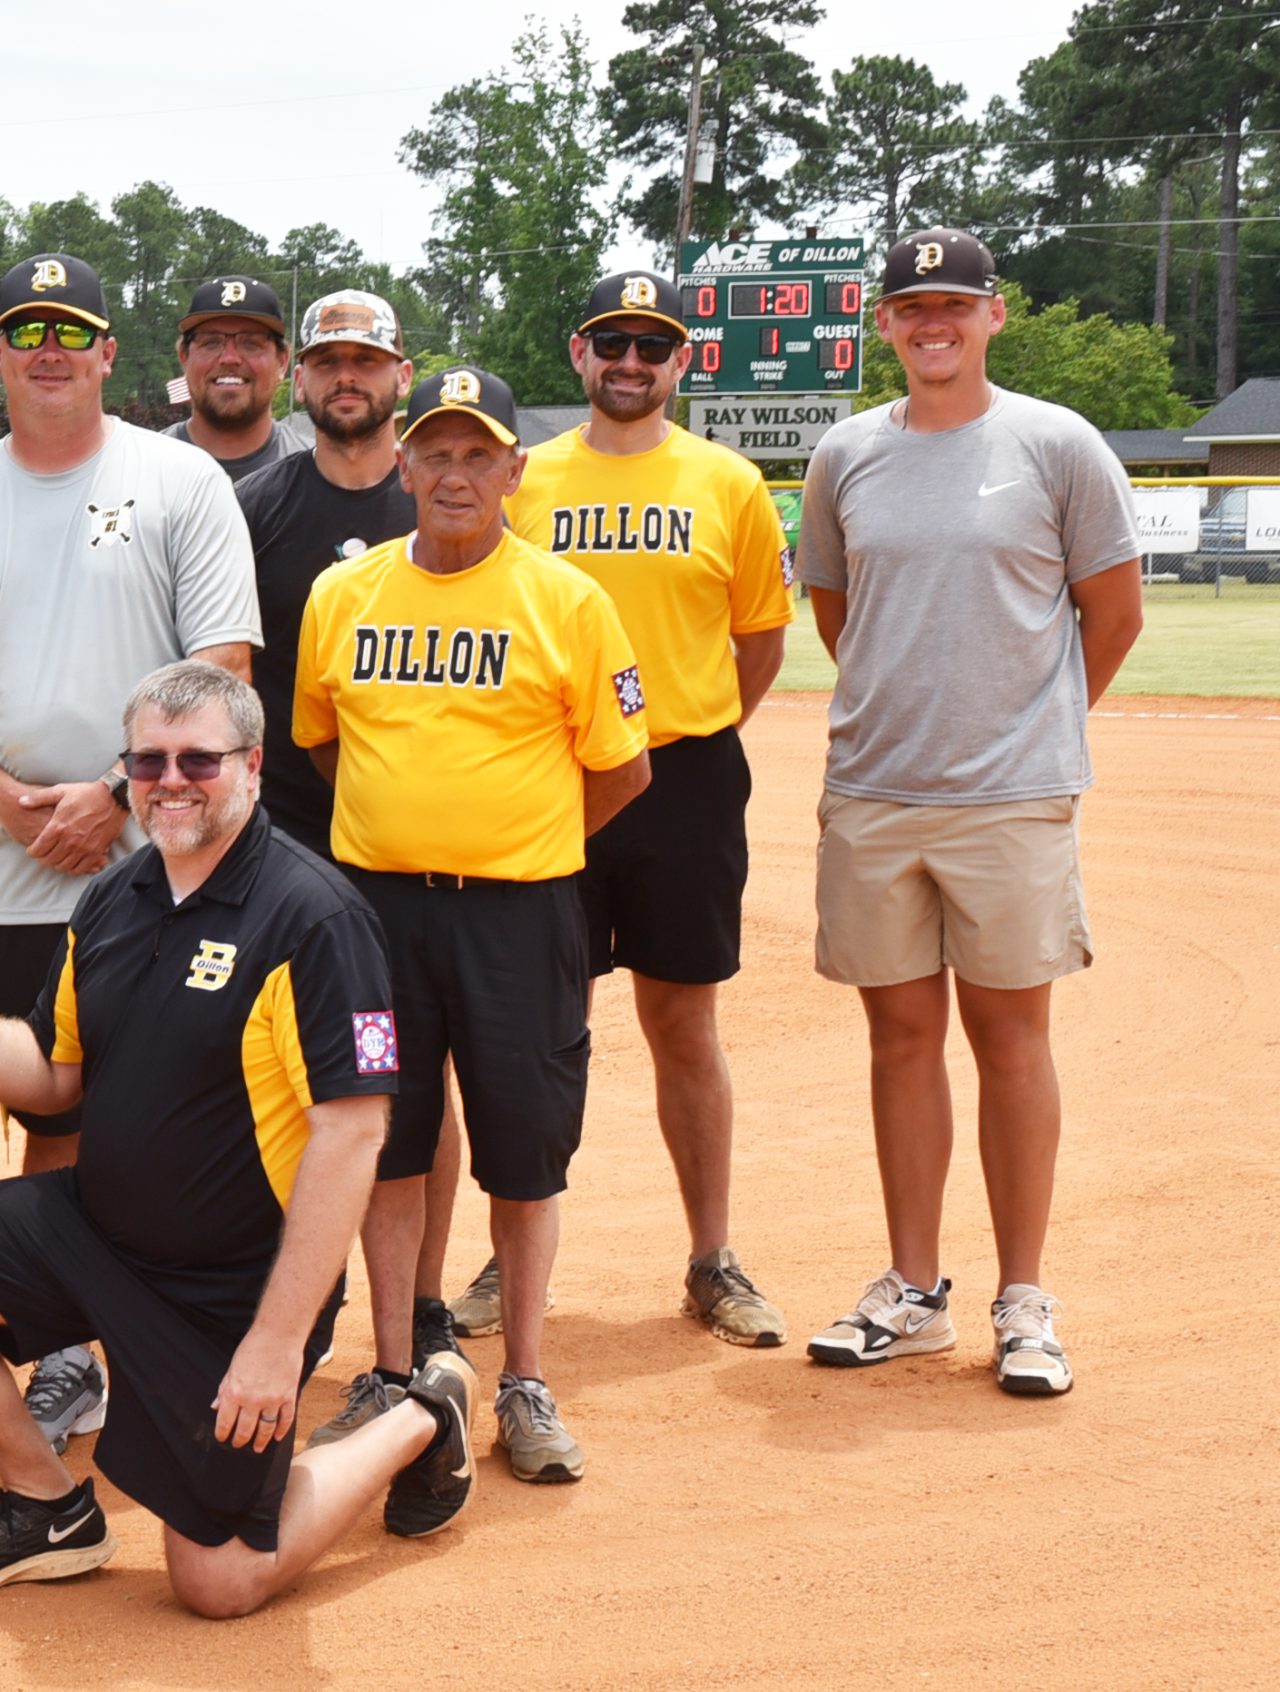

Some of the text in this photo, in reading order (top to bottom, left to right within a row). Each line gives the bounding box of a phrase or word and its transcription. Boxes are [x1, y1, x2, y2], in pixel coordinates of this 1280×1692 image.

[692, 241, 861, 266] ACE OF DILLON
[692, 262, 773, 274] HARDWARE
[680, 277, 717, 286] PITCHES
[824, 273, 861, 283] PITCHES
[698, 286, 716, 316] 0
[759, 284, 809, 315] 1:20
[841, 283, 860, 314] 0
[813, 324, 860, 339] GUEST
[771, 328, 779, 355] 1
[702, 342, 720, 372] 0
[835, 339, 853, 370] 0
[750, 360, 787, 372] INNING
[825, 370, 844, 379] OUT
[691, 373, 713, 382] BALL
[753, 371, 784, 381] STRIKE
[704, 407, 838, 424] RAY WILSON
[738, 431, 800, 448] FIELD
[551, 502, 695, 557] DILLON
[350, 622, 511, 690] DILLON
[197, 960, 230, 973] Dillon
